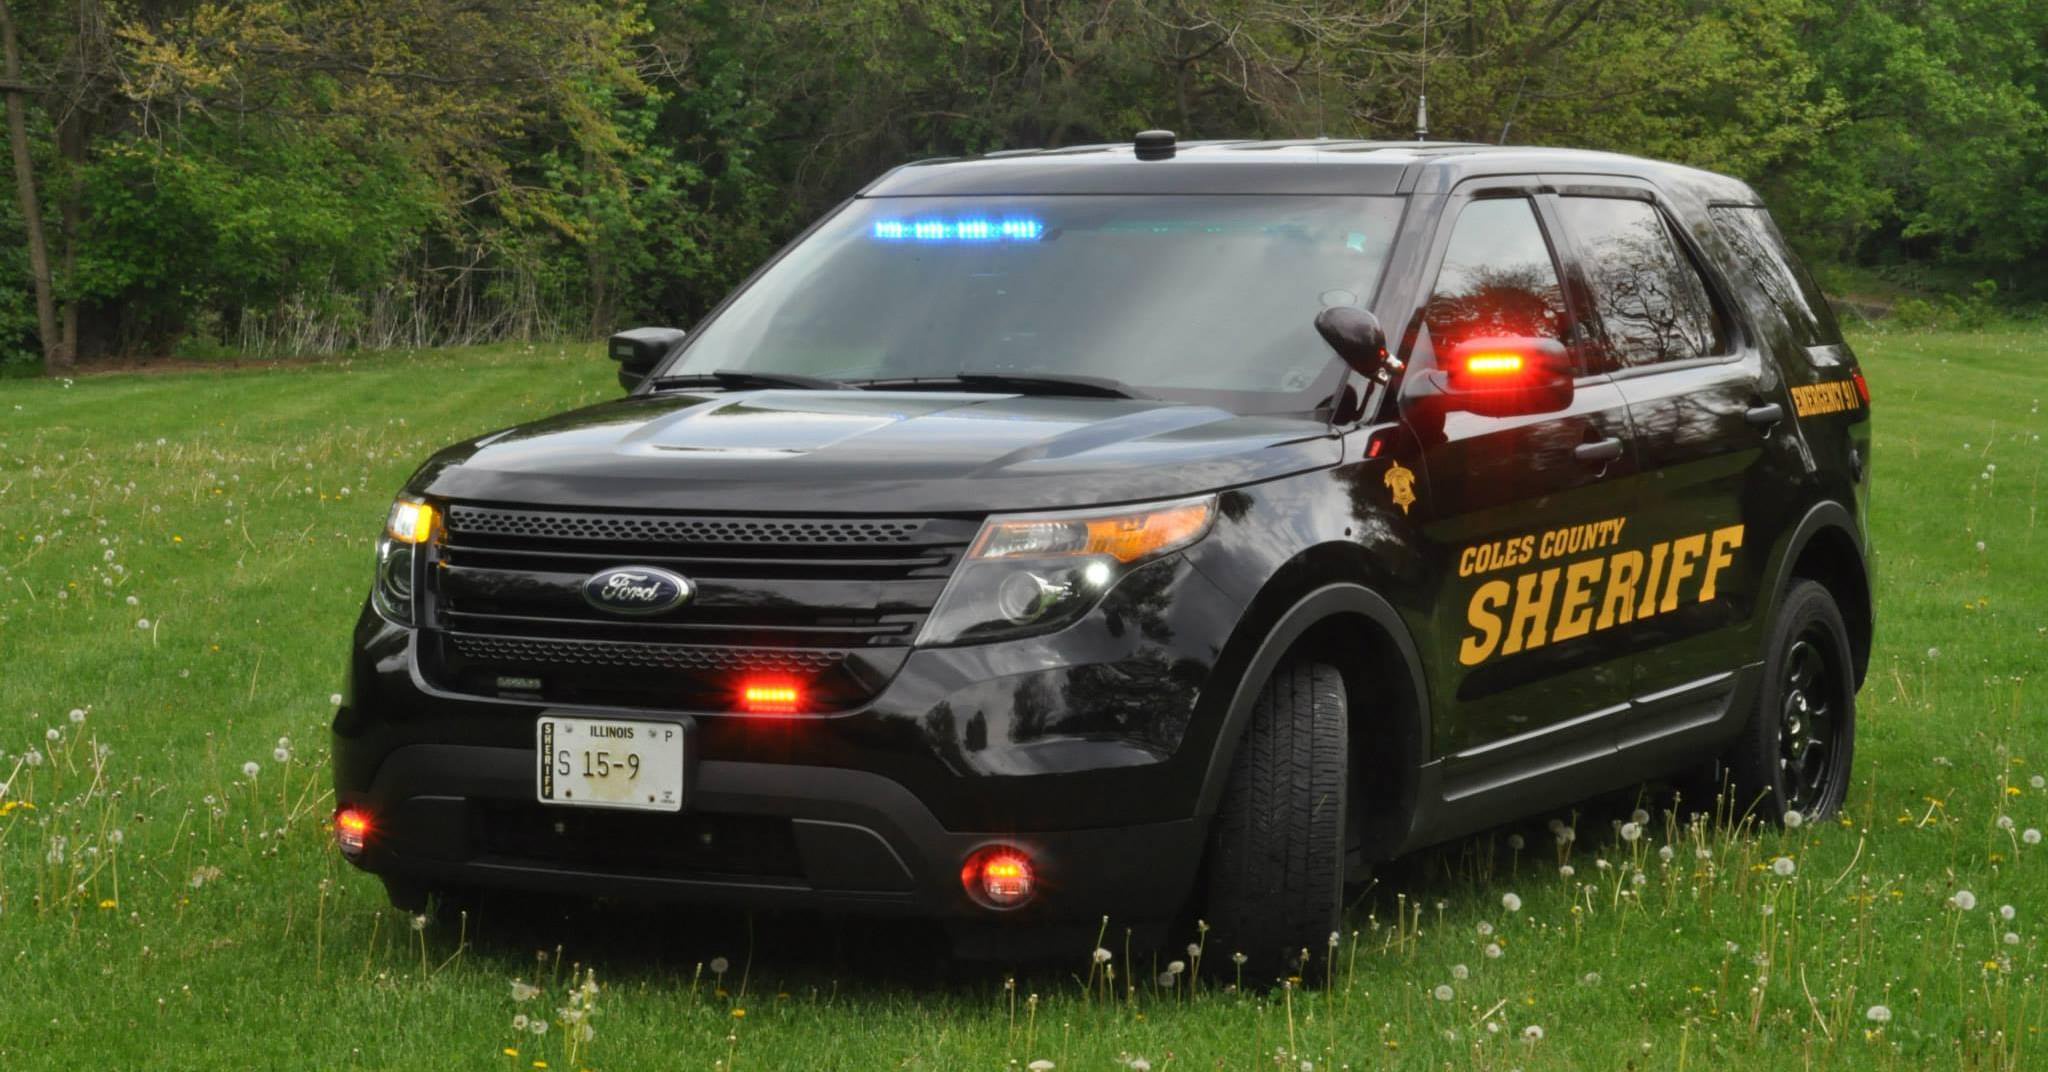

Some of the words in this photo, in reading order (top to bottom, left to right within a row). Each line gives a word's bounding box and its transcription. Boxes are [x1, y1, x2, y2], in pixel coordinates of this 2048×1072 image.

[1459, 535, 1534, 577] COLES
[1539, 516, 1627, 559] COUNTY
[601, 573, 661, 601] Ford
[1459, 524, 1745, 667] SHERIFF
[590, 725, 634, 739] ILLINOIS
[664, 730, 673, 742] P
[544, 724, 553, 796] SHERIFF
[557, 750, 571, 776] S
[582, 751, 640, 779] 15-9
